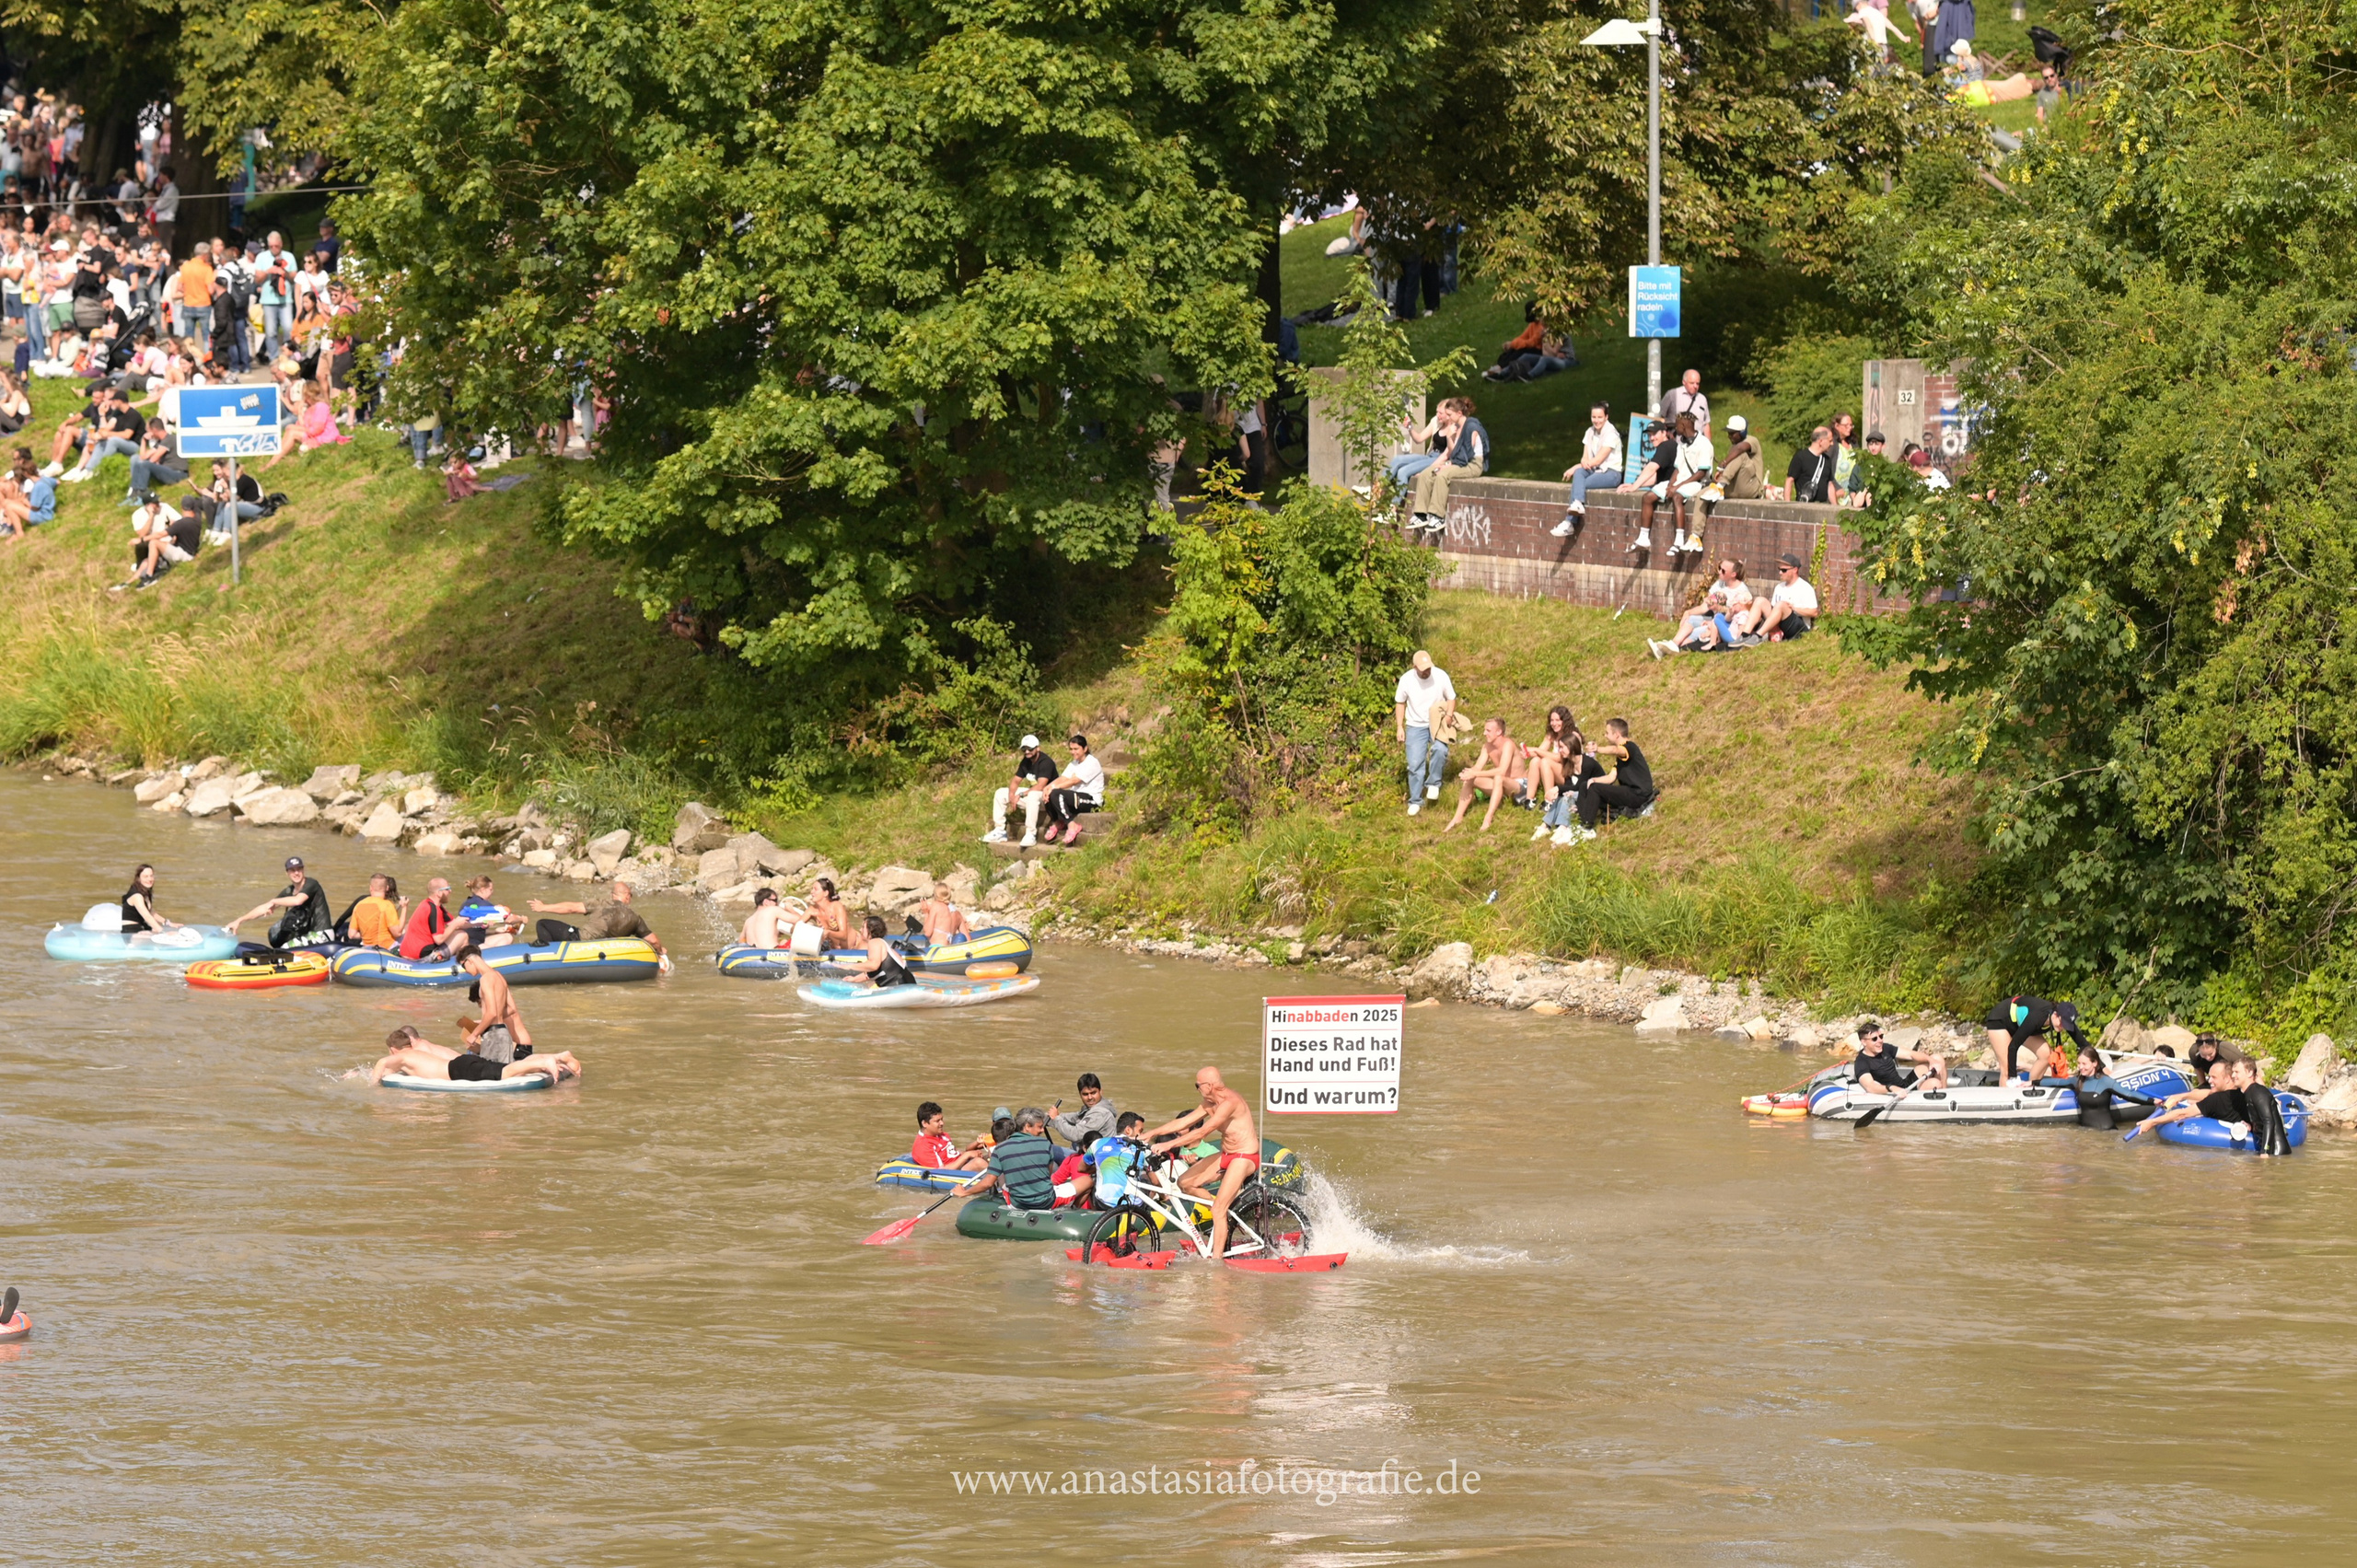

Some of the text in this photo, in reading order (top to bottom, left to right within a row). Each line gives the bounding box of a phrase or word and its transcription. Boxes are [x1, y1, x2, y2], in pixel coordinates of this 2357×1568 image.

[1638, 281, 1672, 290] Bitte mit
[1638, 291, 1678, 301] Rücksicht
[1900, 392, 1912, 402] 32
[572, 940, 643, 952] CHALLENGER
[387, 959, 412, 971] INTEX
[1271, 1009, 1398, 1023] Hinabbaden 2025
[1271, 1037, 1398, 1051] Dieses Rad hat
[1271, 1057, 1395, 1072] Hand und Fuß!
[2161, 1069, 2170, 1079] 4
[1270, 1087, 1397, 1104] Und warum?
[900, 1167, 923, 1176] INTEX
[1184, 1214, 1204, 1246] varibike
